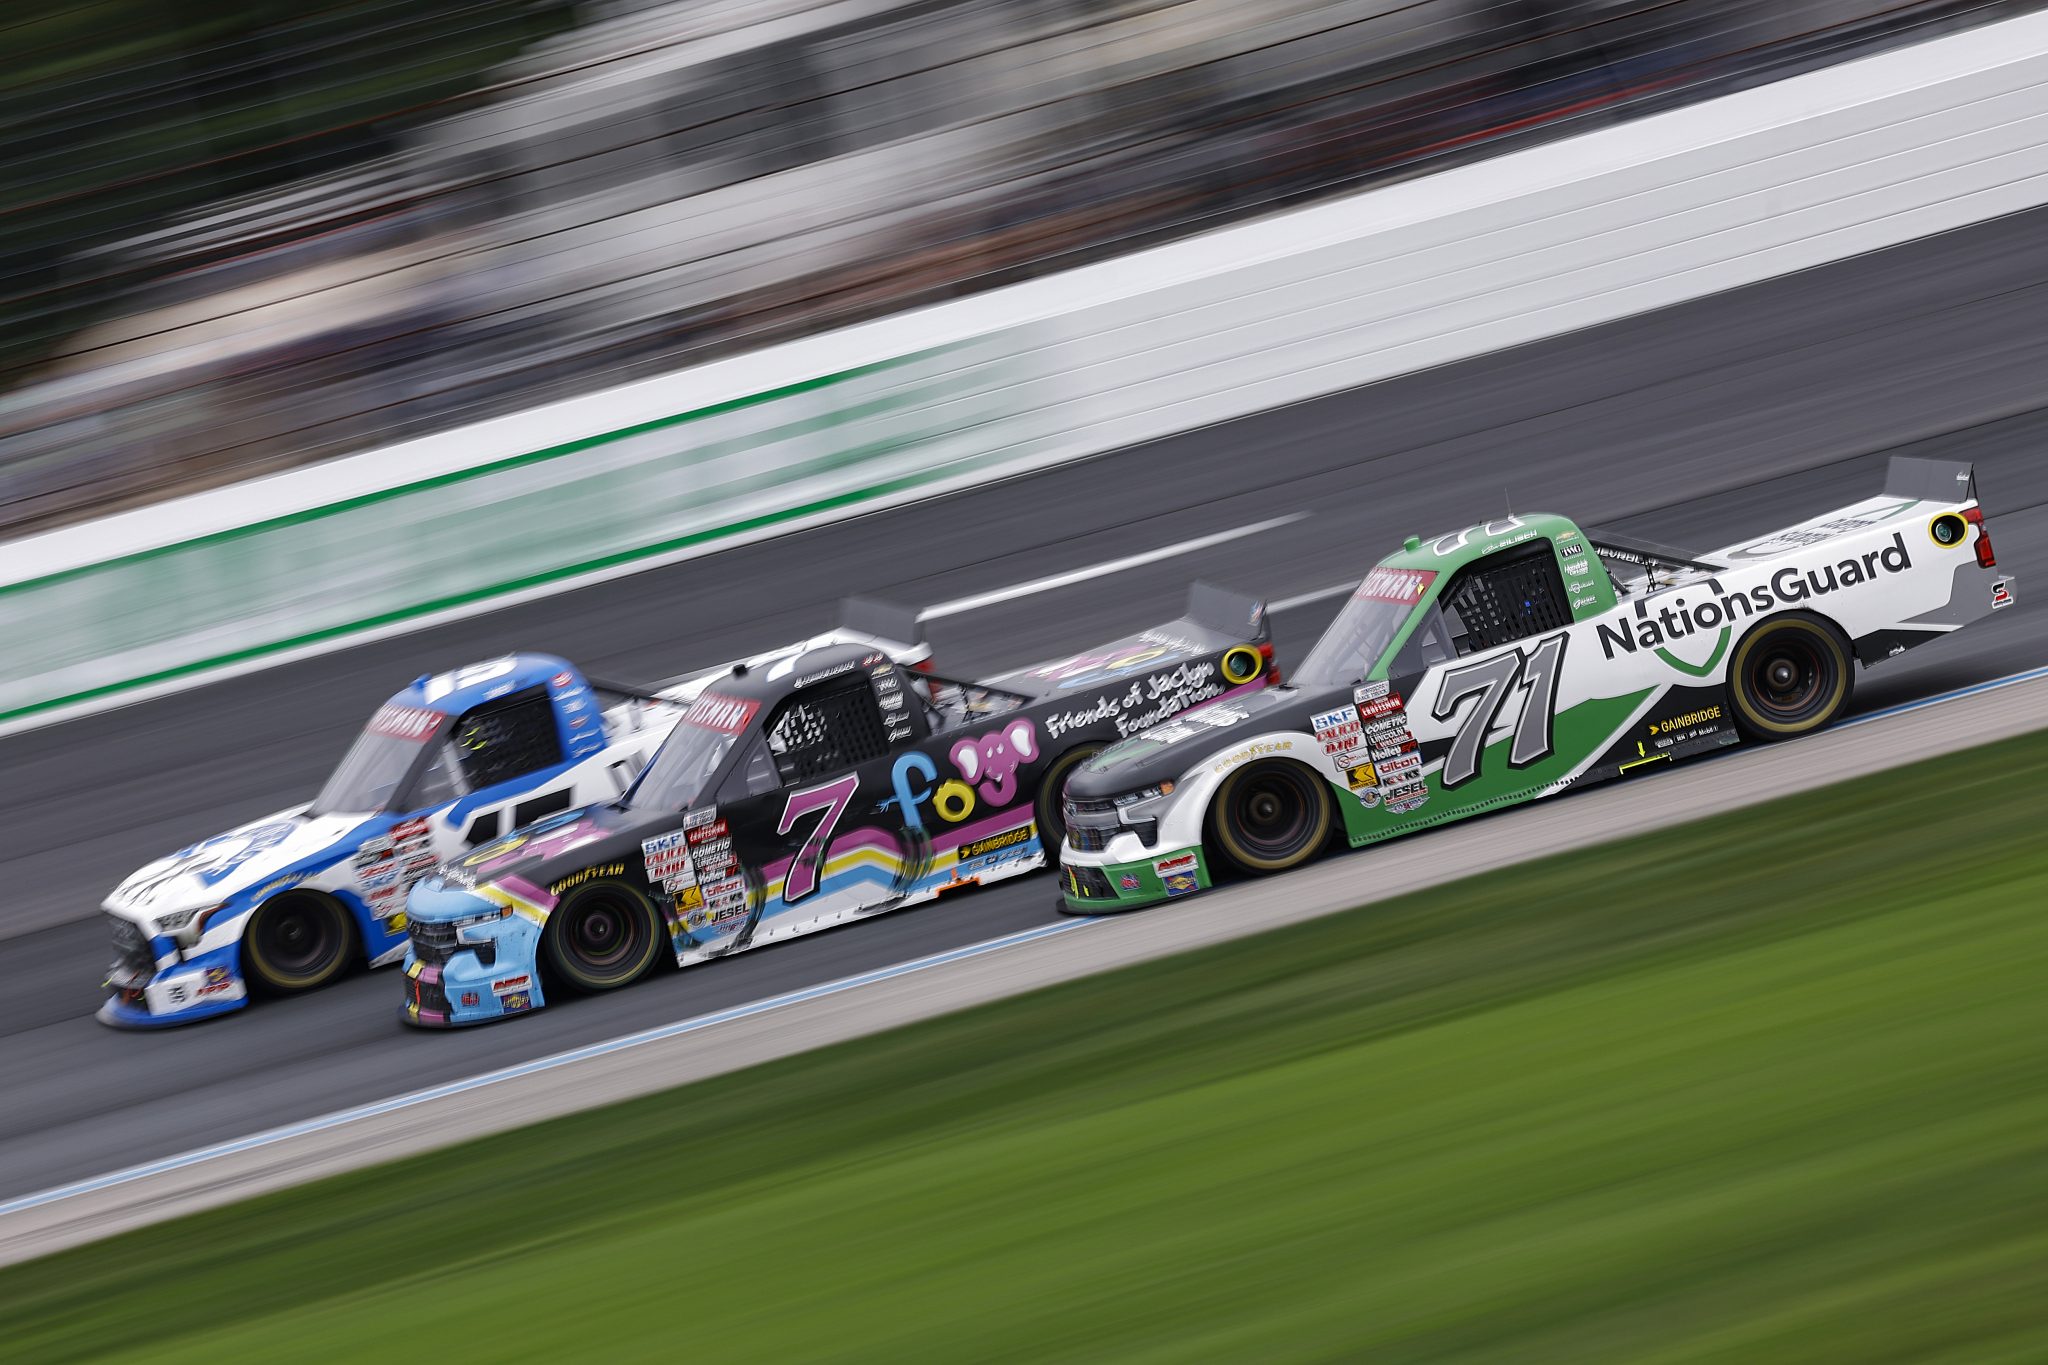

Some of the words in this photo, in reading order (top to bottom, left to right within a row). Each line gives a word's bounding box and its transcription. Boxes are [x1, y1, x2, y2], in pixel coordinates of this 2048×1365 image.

[1596, 532, 1913, 661] NationsGuard
[1044, 695, 1121, 740] Friends
[1122, 681, 1144, 710] of
[1114, 681, 1220, 739] Foundation
[1315, 708, 1355, 729] SKF
[1431, 631, 1571, 791] 71
[1660, 705, 1722, 733] GAINBRIDGE
[1365, 715, 1407, 735] COMETIC
[1370, 728, 1405, 744] LINCOLN
[1213, 741, 1293, 774] GOODYEAR
[1370, 744, 1402, 762] Holley
[1385, 780, 1428, 801] JESEL
[645, 833, 682, 854] SKF
[692, 839, 731, 859] COMETIC
[776, 770, 860, 905] 7
[971, 827, 1030, 856] GAINBRIDGE
[550, 862, 625, 897] GOODYEAR
[711, 903, 750, 923] JESEL
